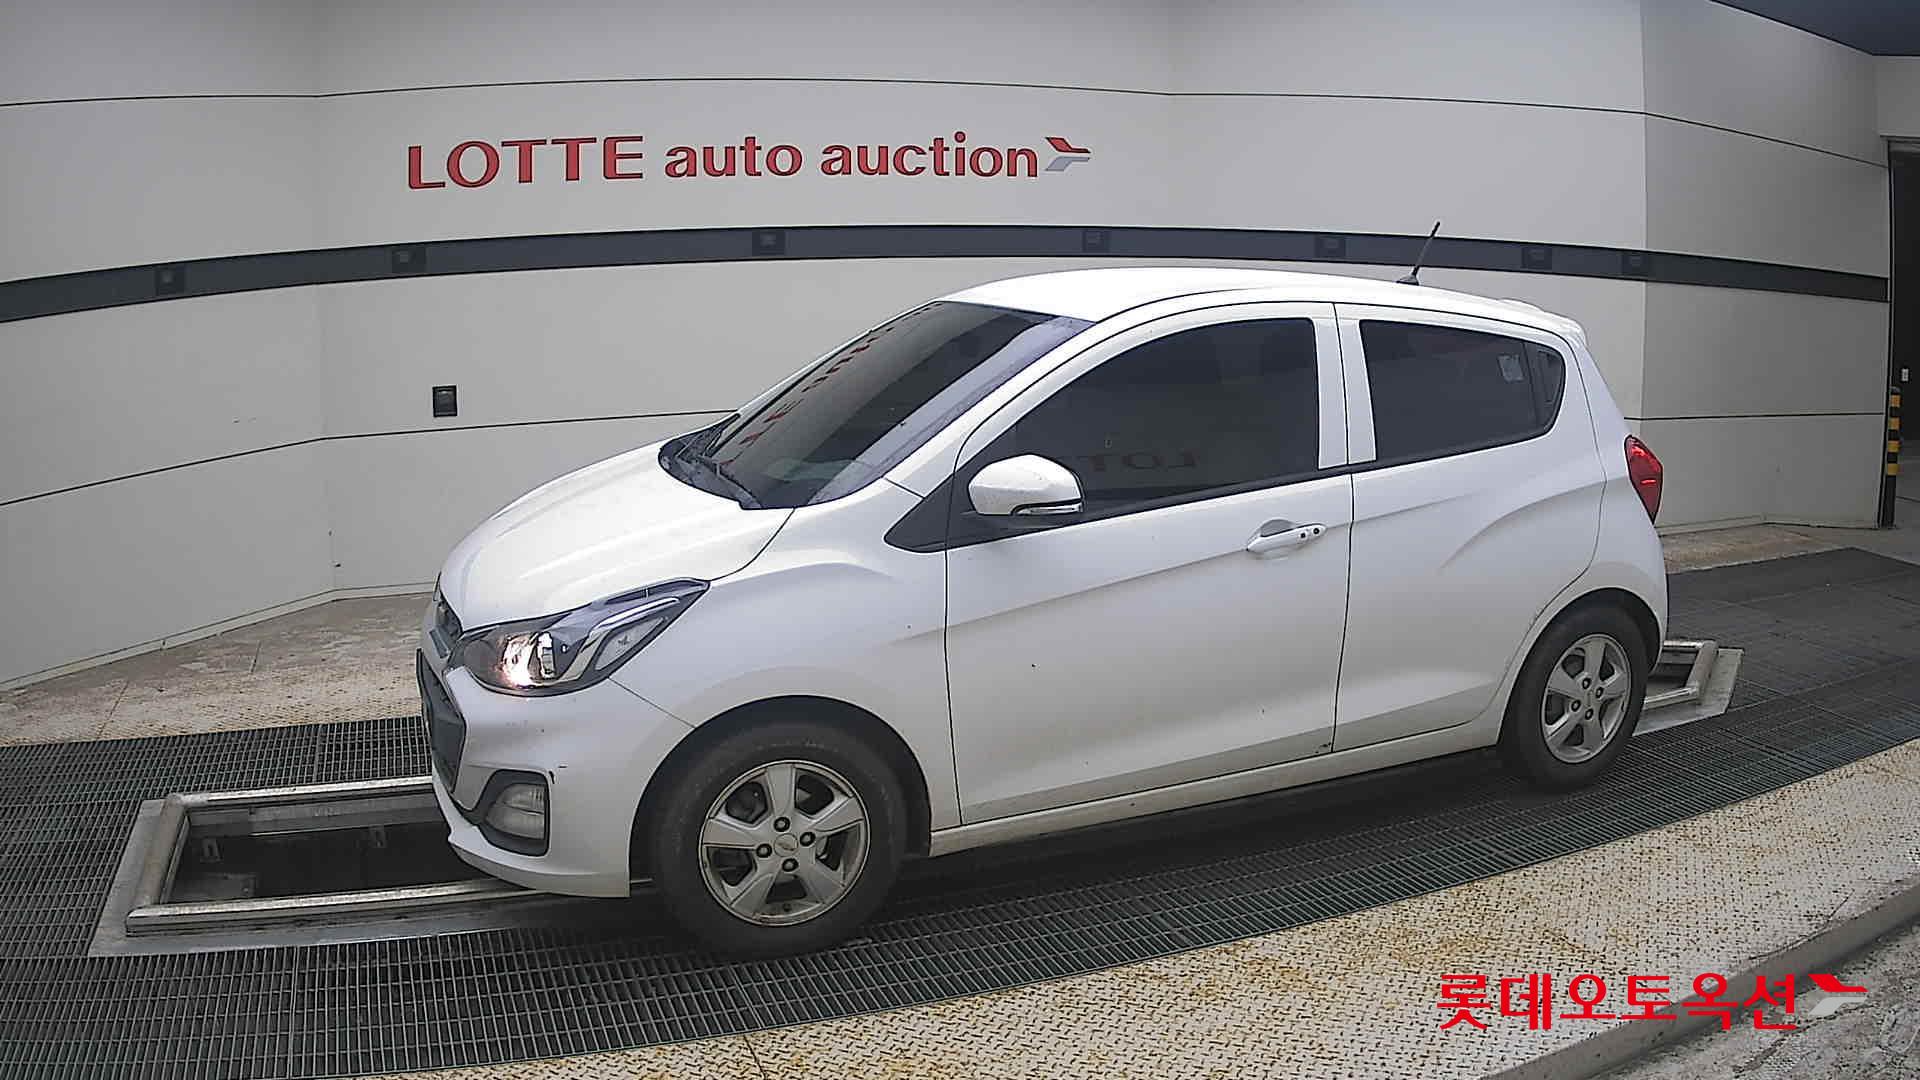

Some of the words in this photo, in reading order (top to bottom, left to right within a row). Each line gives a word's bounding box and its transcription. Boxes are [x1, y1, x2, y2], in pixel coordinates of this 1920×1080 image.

[408, 136, 644, 190] LOTTE
[664, 136, 803, 178] auto
[820, 131, 1039, 178] auction
